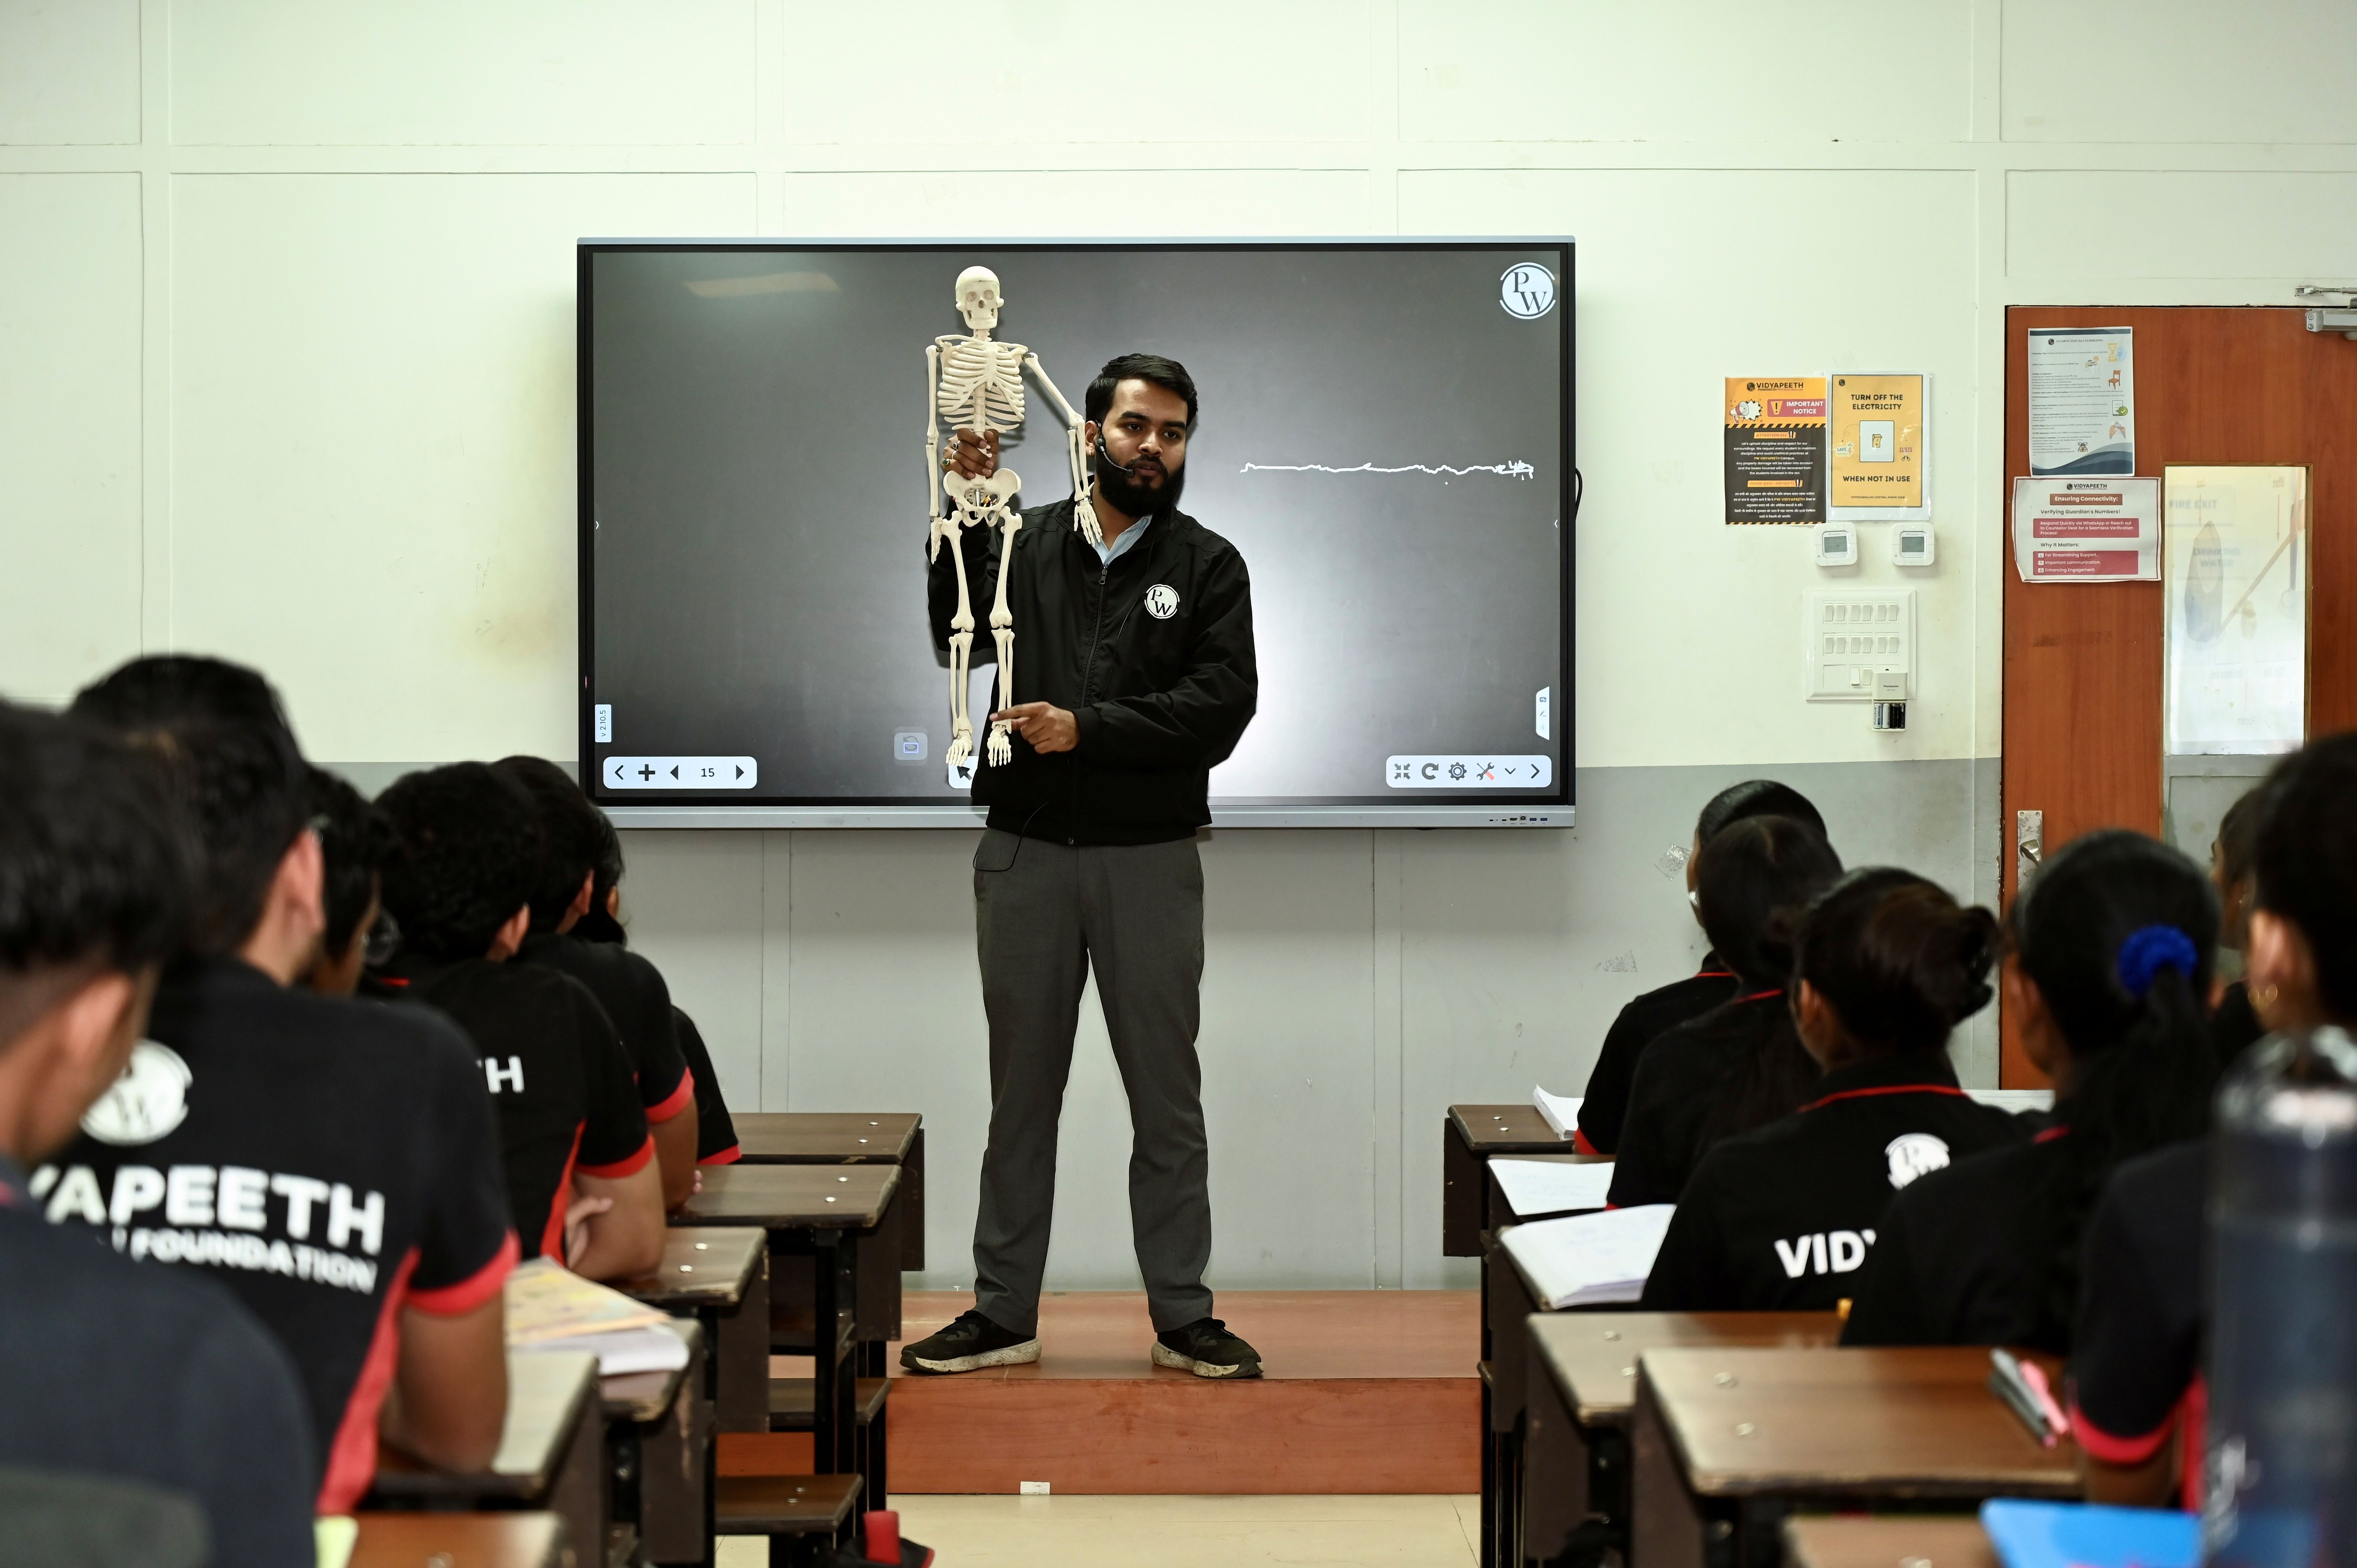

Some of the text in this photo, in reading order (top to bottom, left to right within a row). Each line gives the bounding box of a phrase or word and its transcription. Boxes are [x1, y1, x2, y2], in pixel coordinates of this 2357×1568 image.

[2170, 500, 2218, 508] FIRE EXIT
[1151, 589, 1172, 615] PW
[701, 768, 715, 777] 15
[476, 1055, 525, 1094] H
[131, 1227, 378, 1294] FOUNDATION
